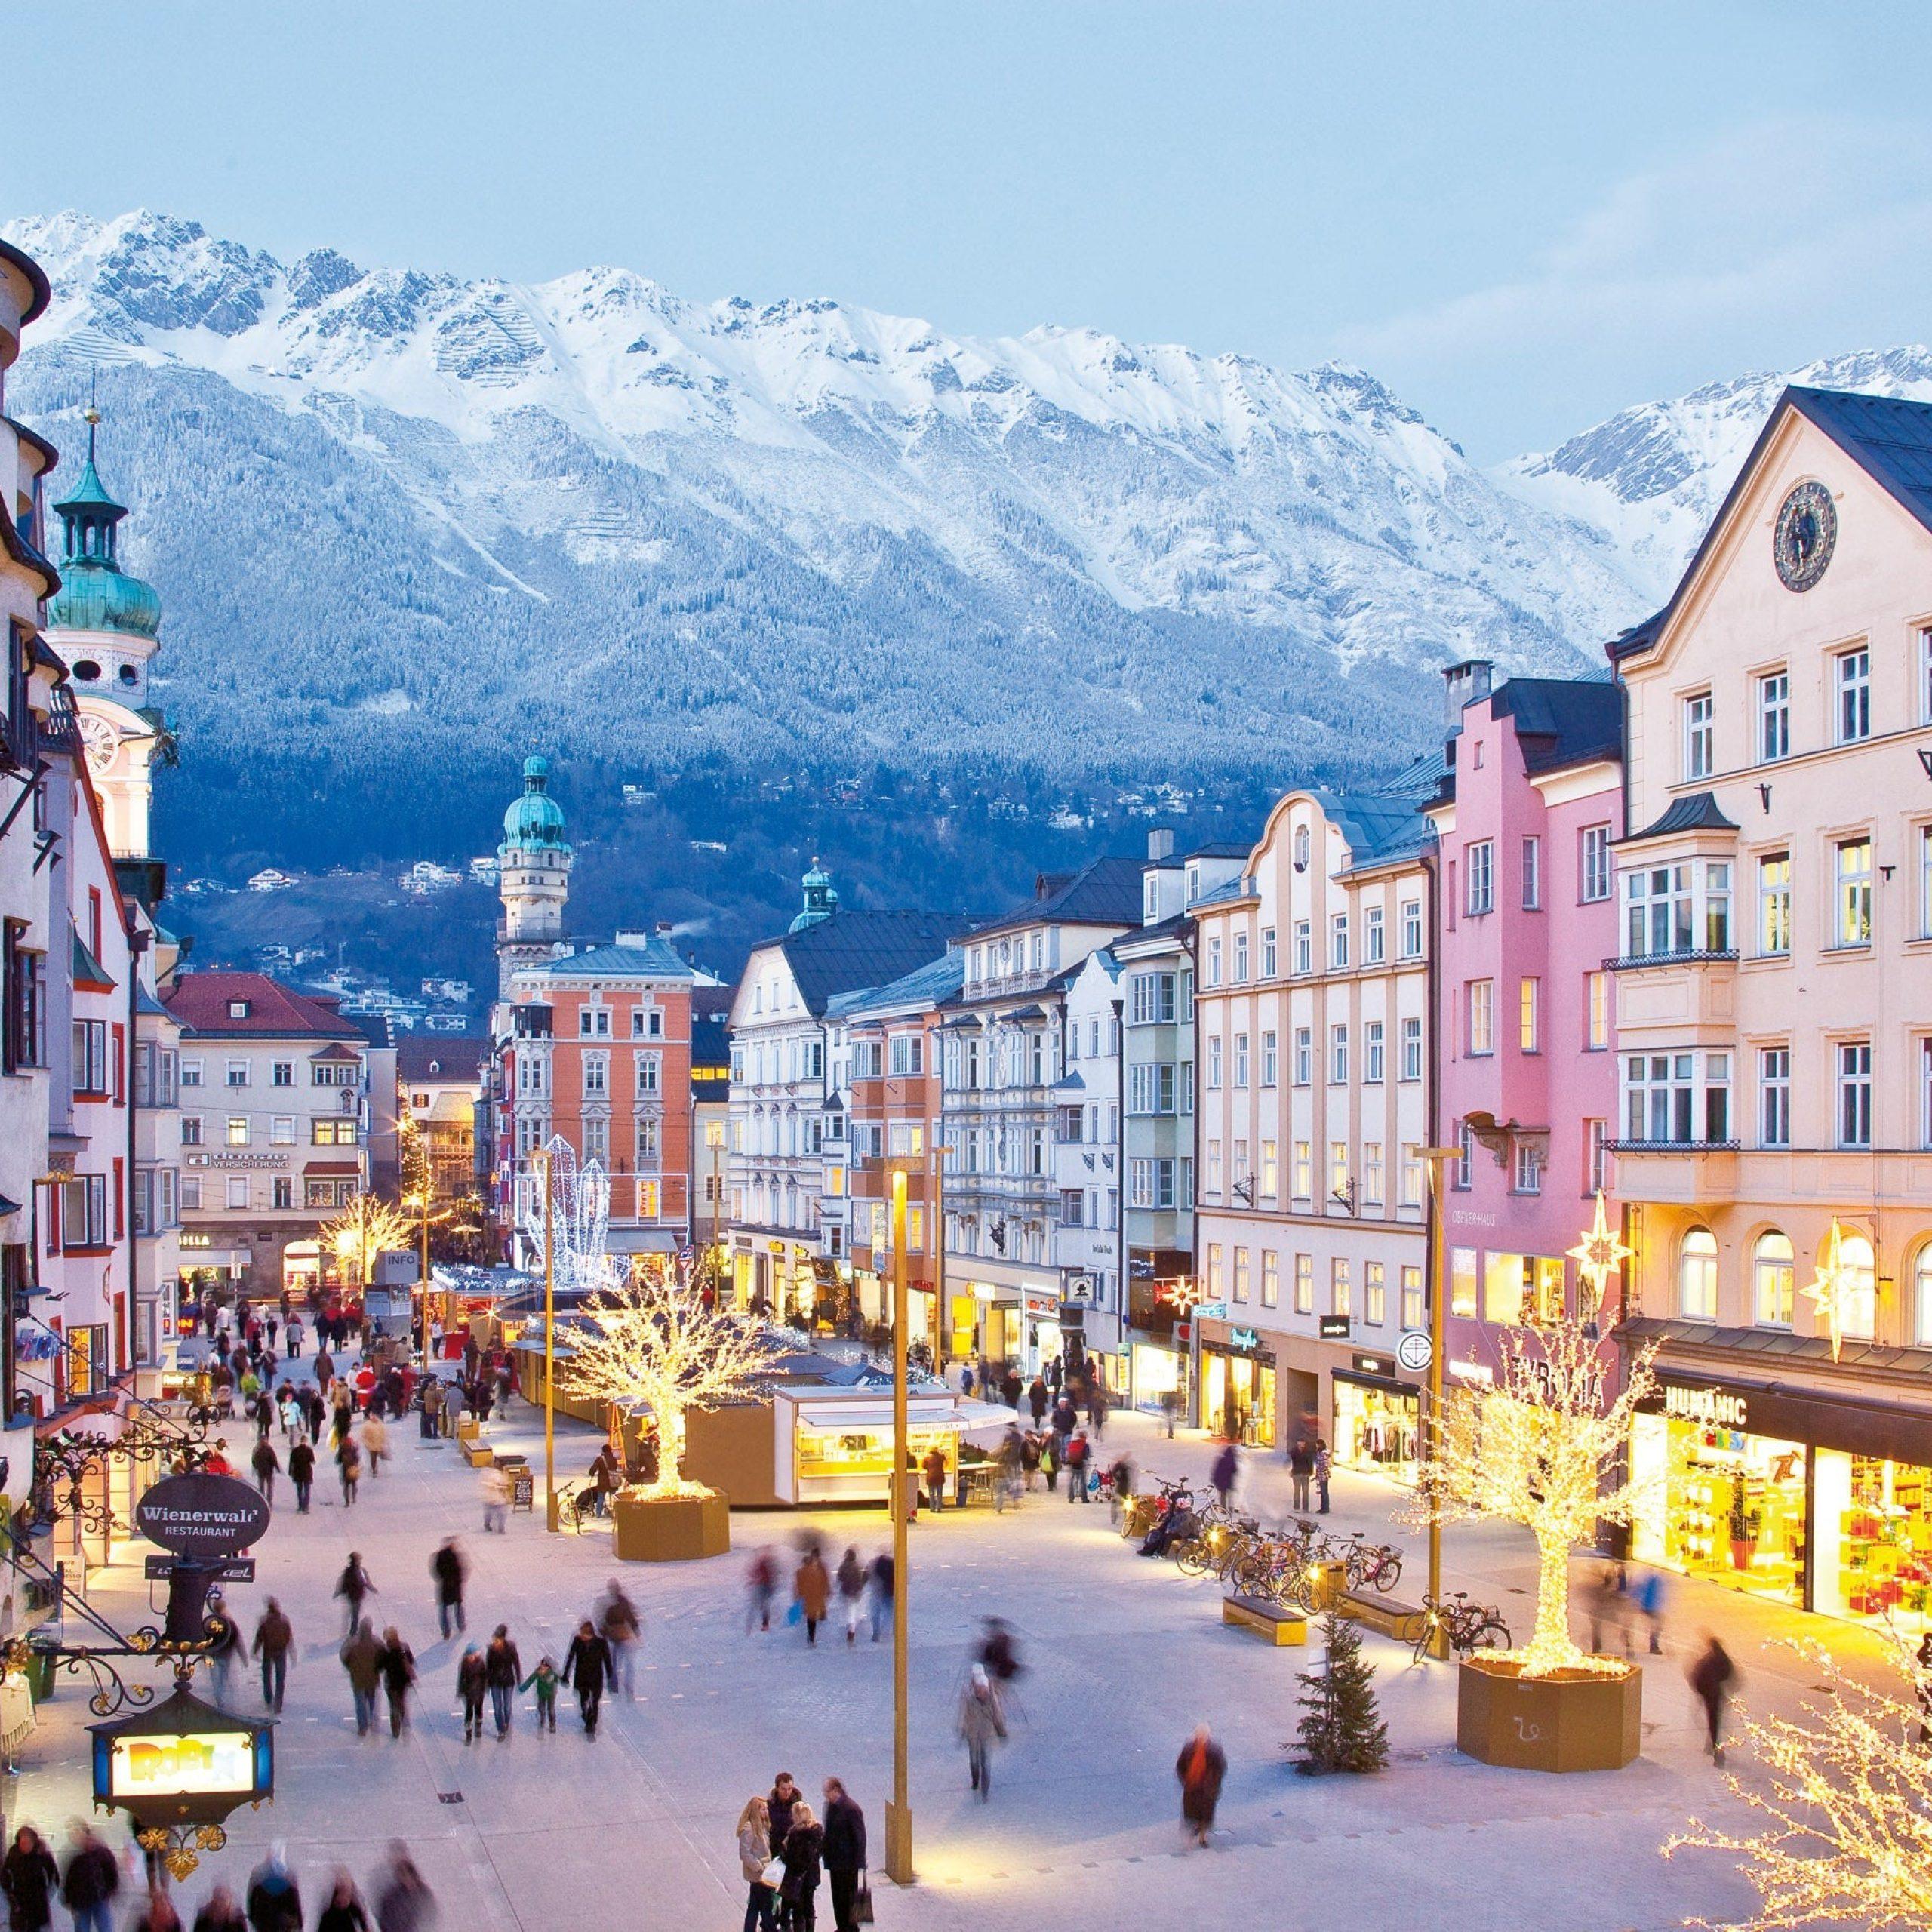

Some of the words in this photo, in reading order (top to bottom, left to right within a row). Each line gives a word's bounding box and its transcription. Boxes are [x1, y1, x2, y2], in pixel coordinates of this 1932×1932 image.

[213, 1152, 288, 1160] donau
[388, 1255, 415, 1266] INFO
[1666, 1386, 1747, 1426] HUMANIC
[165, 1526, 236, 1537] RESTAURANT
